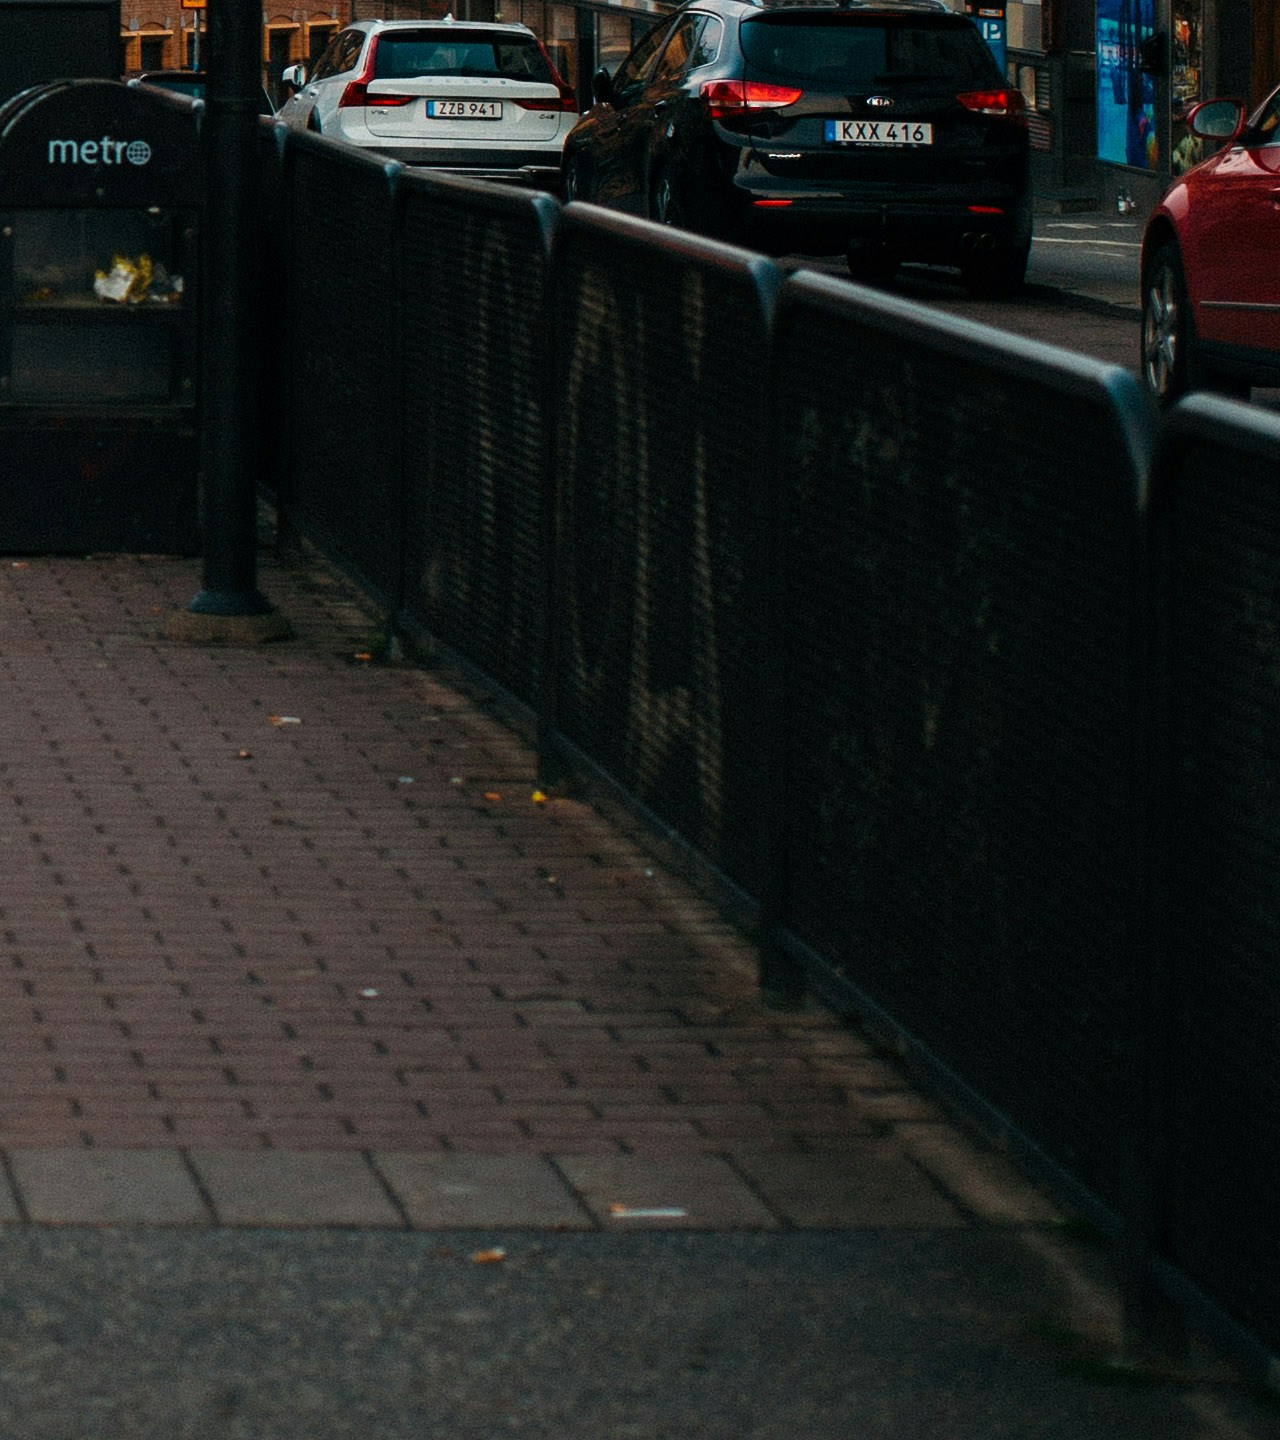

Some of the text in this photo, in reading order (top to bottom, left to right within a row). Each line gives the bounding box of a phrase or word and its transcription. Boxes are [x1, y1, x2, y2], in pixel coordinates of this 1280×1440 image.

[439, 102, 495, 117] ZZB 941
[843, 122, 924, 142] KXX 416
